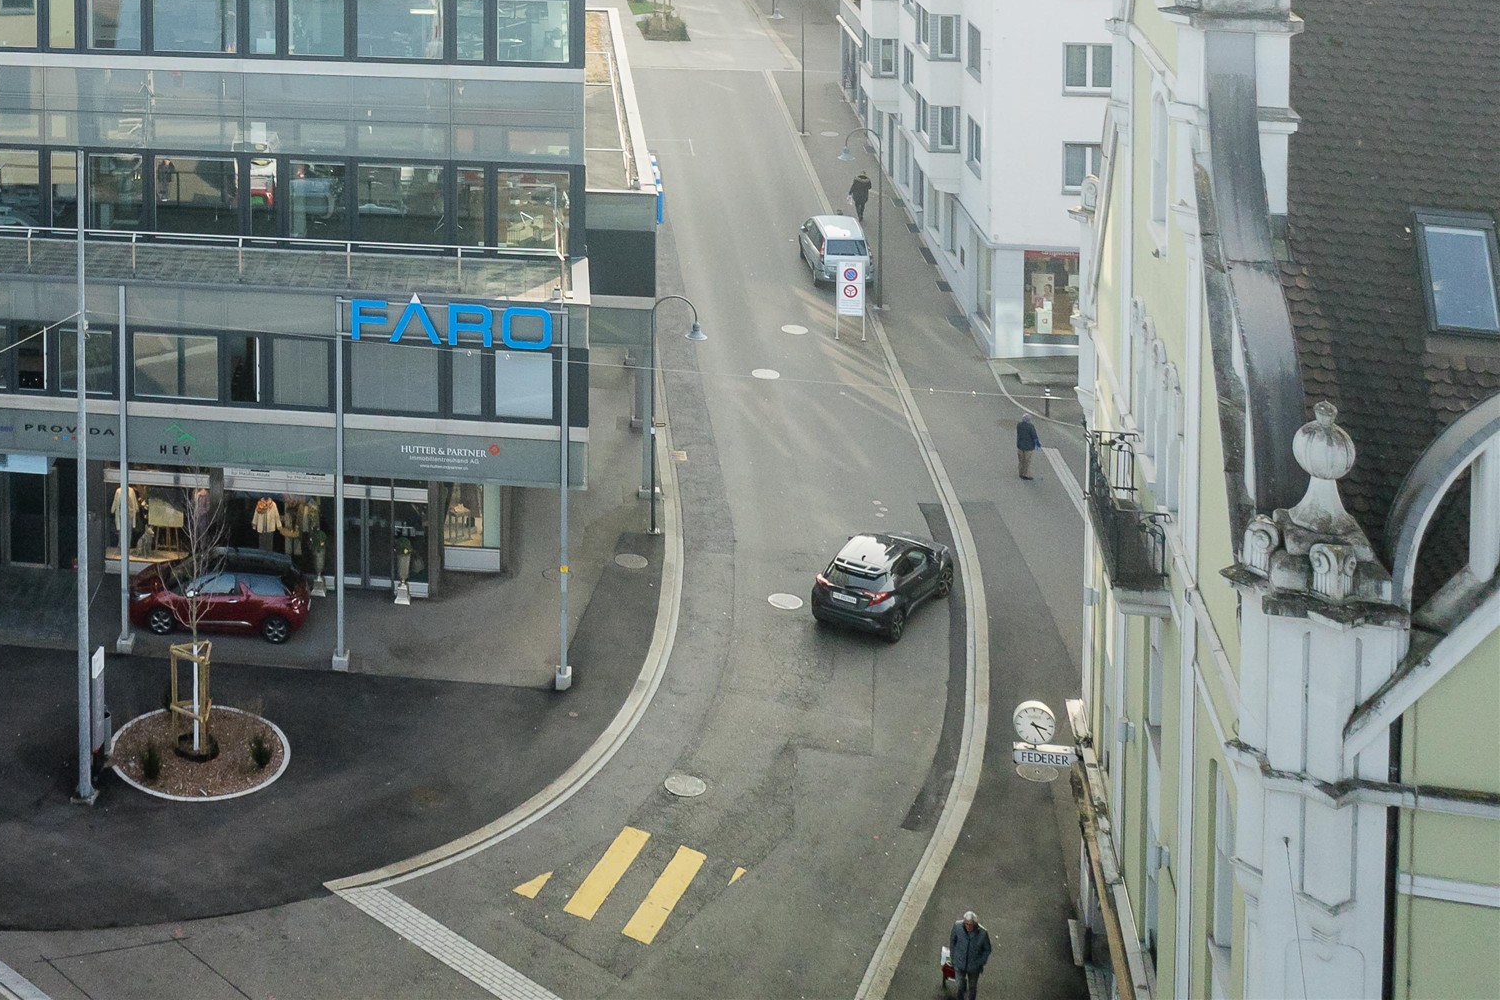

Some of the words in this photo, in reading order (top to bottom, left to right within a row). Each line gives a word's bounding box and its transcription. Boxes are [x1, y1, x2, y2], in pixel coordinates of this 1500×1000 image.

[351, 292, 553, 350] FARO
[24, 424, 115, 437] PROVDA
[159, 444, 191, 456] HEV
[401, 445, 437, 455] HUTTER
[437, 447, 446, 455] &
[446, 447, 487, 458] PARTNER
[1021, 751, 1070, 766] FEDERER
